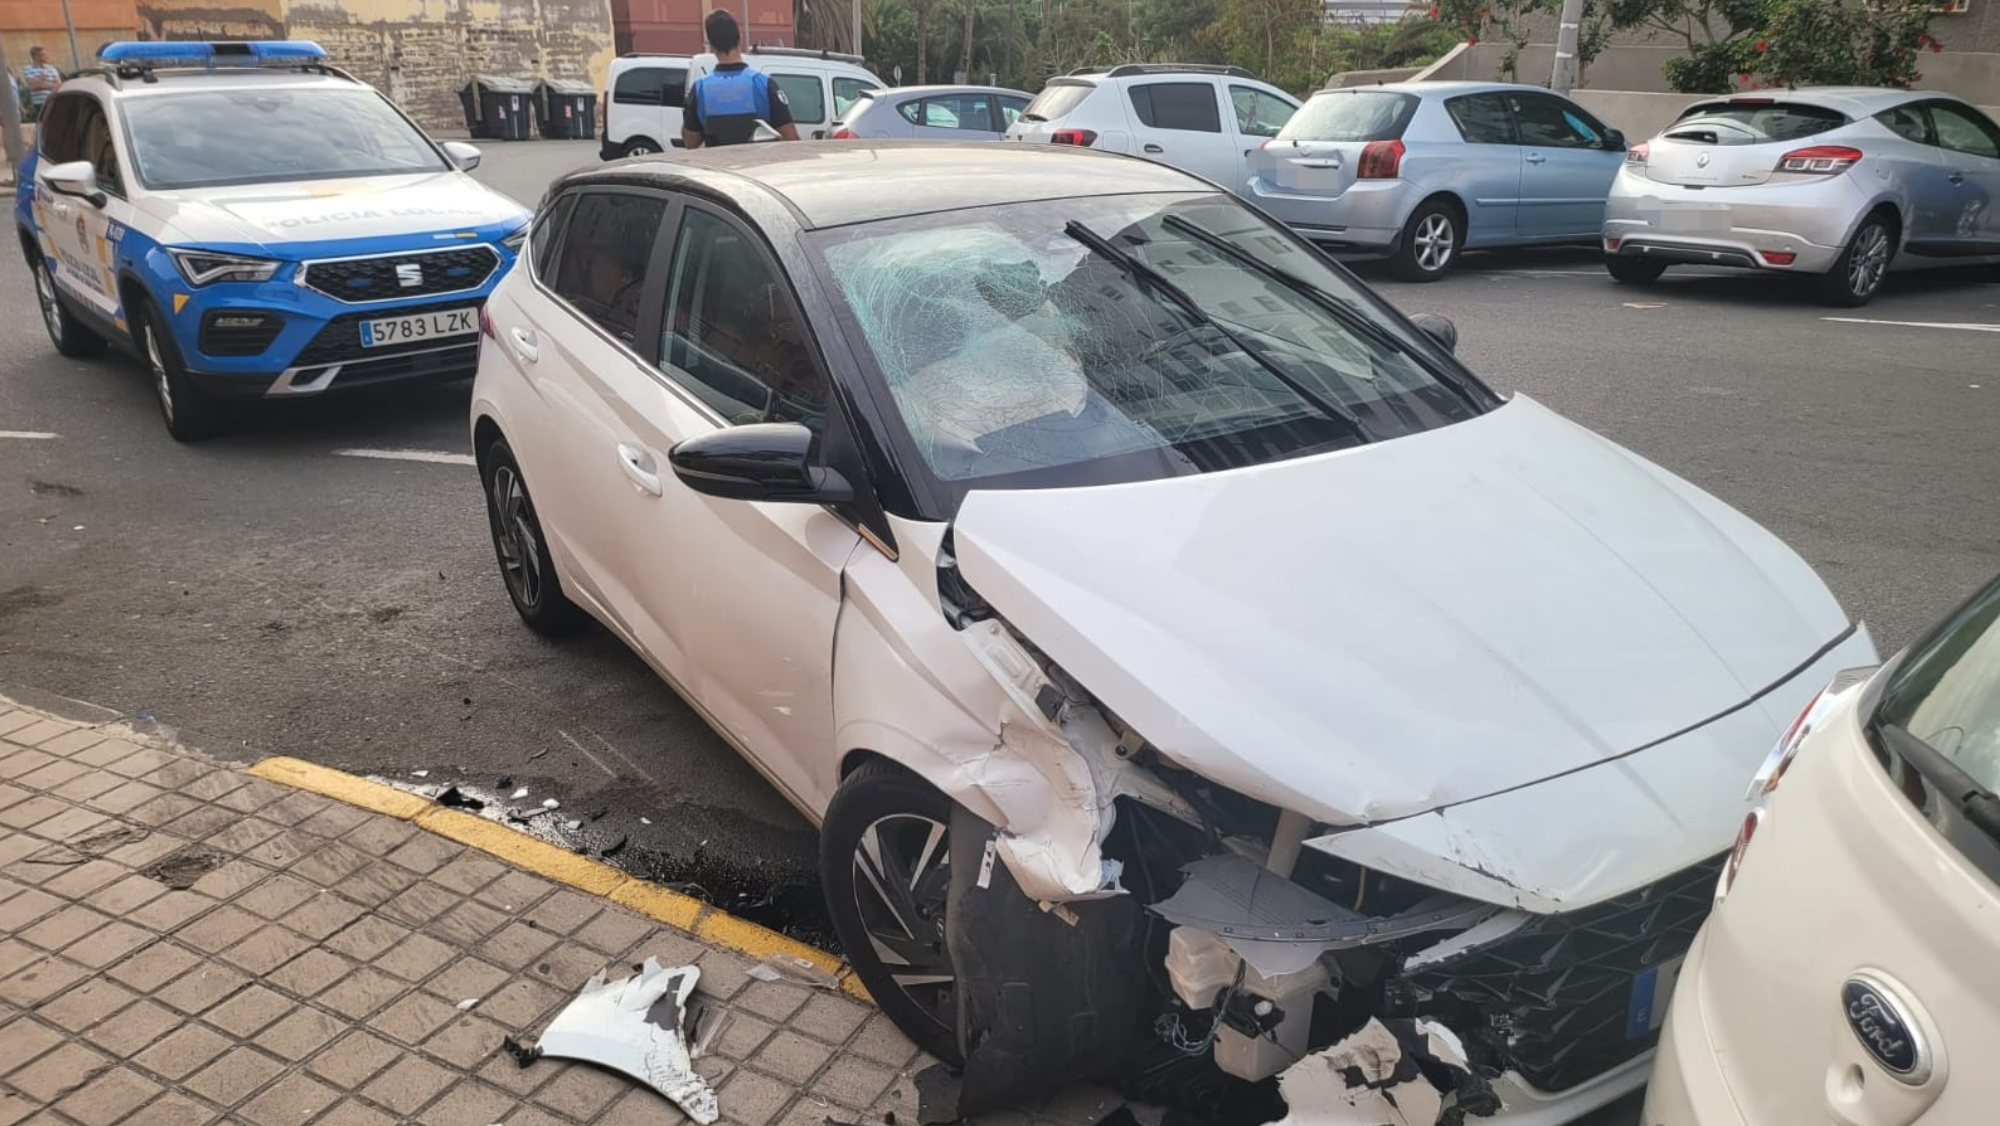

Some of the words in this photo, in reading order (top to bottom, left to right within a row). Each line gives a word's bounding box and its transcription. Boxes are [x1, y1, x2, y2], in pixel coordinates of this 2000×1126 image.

[373, 318, 427, 341] 5783
[433, 311, 472, 334] LZK
[1850, 992, 1905, 1058] Ford
